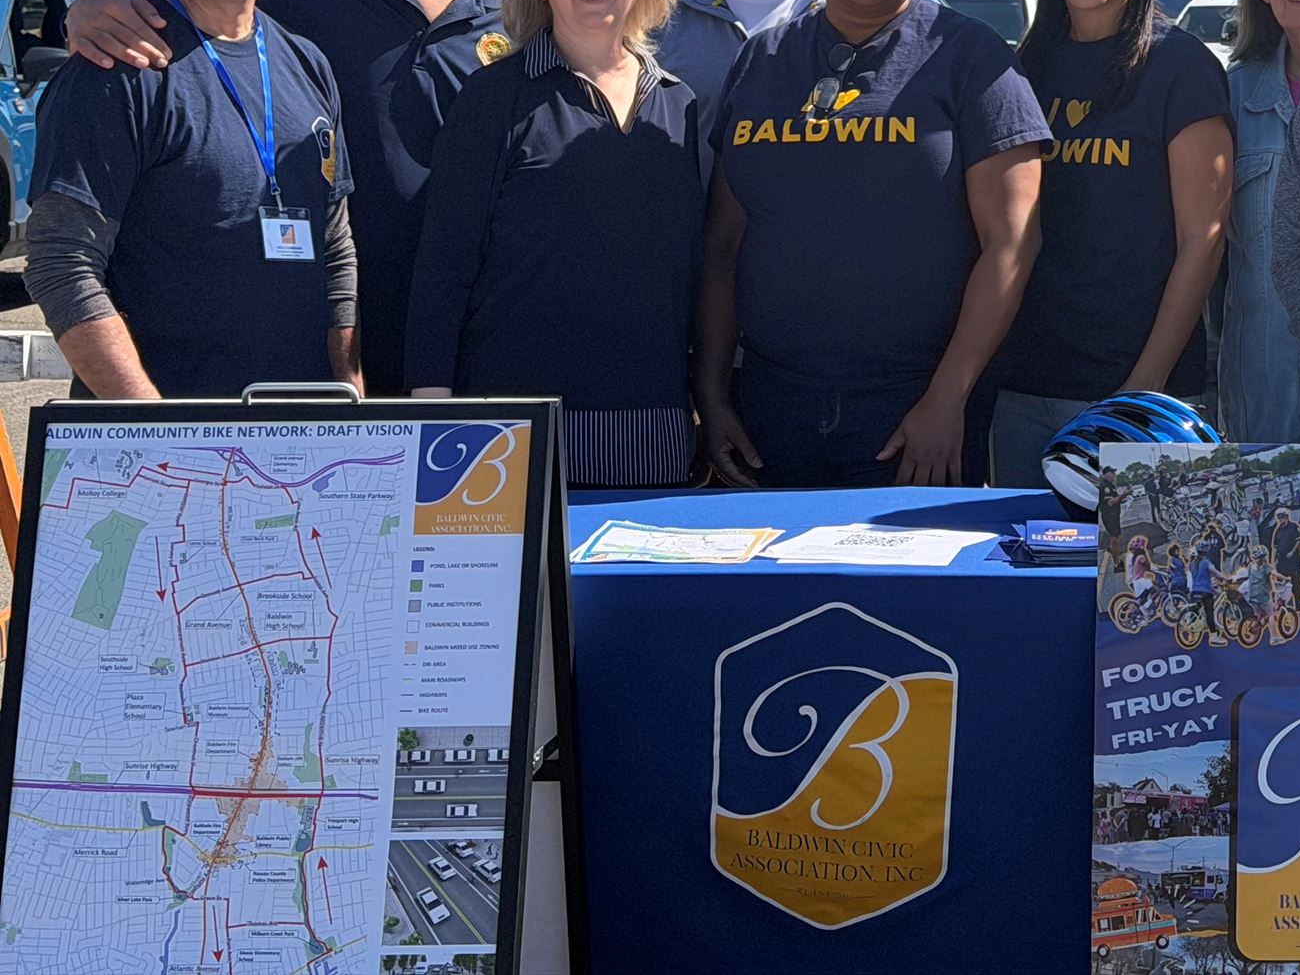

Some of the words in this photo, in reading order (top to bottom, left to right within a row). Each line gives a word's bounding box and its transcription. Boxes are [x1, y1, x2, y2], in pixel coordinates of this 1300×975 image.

[733, 116, 916, 146] BALDWIN
[107, 426, 199, 439] COMMUNITY
[202, 426, 232, 438] BIKE
[237, 425, 313, 438] NETWORK:
[316, 425, 362, 437] DRAFT
[366, 424, 413, 436] VISION
[102, 489, 126, 498] College
[319, 492, 348, 500] Southern
[350, 492, 366, 500] State
[367, 492, 394, 501] Parkway
[436, 513, 479, 523] BALDWIN
[481, 513, 507, 522] CIVIC
[258, 592, 289, 600] Brookside
[1101, 654, 1193, 688] FOOD
[1106, 681, 1224, 720] TRUCK
[1111, 714, 1219, 750] FRI-YAY
[125, 762, 149, 770] Sunrise
[150, 762, 178, 771] Highway
[325, 756, 349, 764] Sunrise
[351, 756, 378, 765] Highway
[748, 829, 847, 855] BALDWIN
[852, 841, 914, 858] CIVIC
